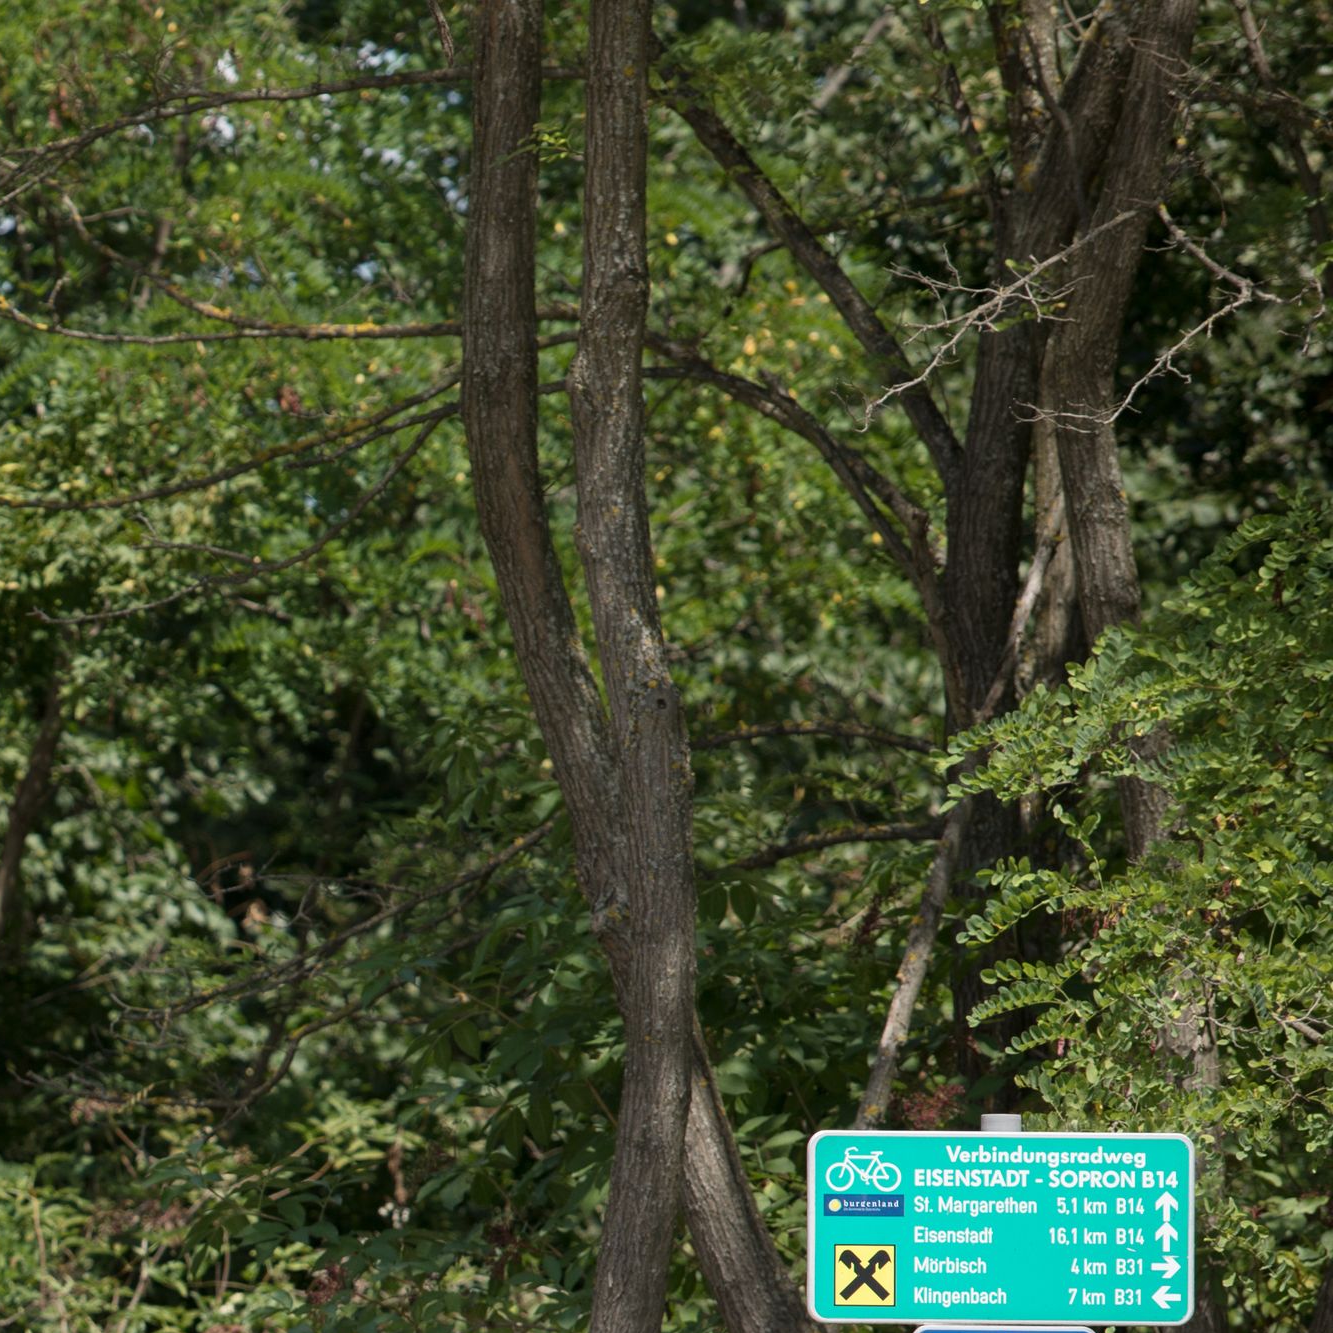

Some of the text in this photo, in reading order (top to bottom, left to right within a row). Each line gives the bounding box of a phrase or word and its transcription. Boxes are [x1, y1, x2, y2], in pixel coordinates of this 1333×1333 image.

[946, 1144, 1147, 1168] Verbindungsradweg
[913, 1169, 1030, 1189] EISENSTADT
[1048, 1169, 1136, 1190] SOPRON
[1141, 1170, 1179, 1190] B14
[843, 1199, 900, 1208] burgenland
[913, 1196, 1145, 1216] St. Margarethen 5,1 km B14
[913, 1226, 1145, 1246] Eisenstadt 16,1 km B14
[913, 1256, 1144, 1276] Mörbisch 4 km B31
[913, 1286, 1142, 1307] Klingenbach 7 km B31
